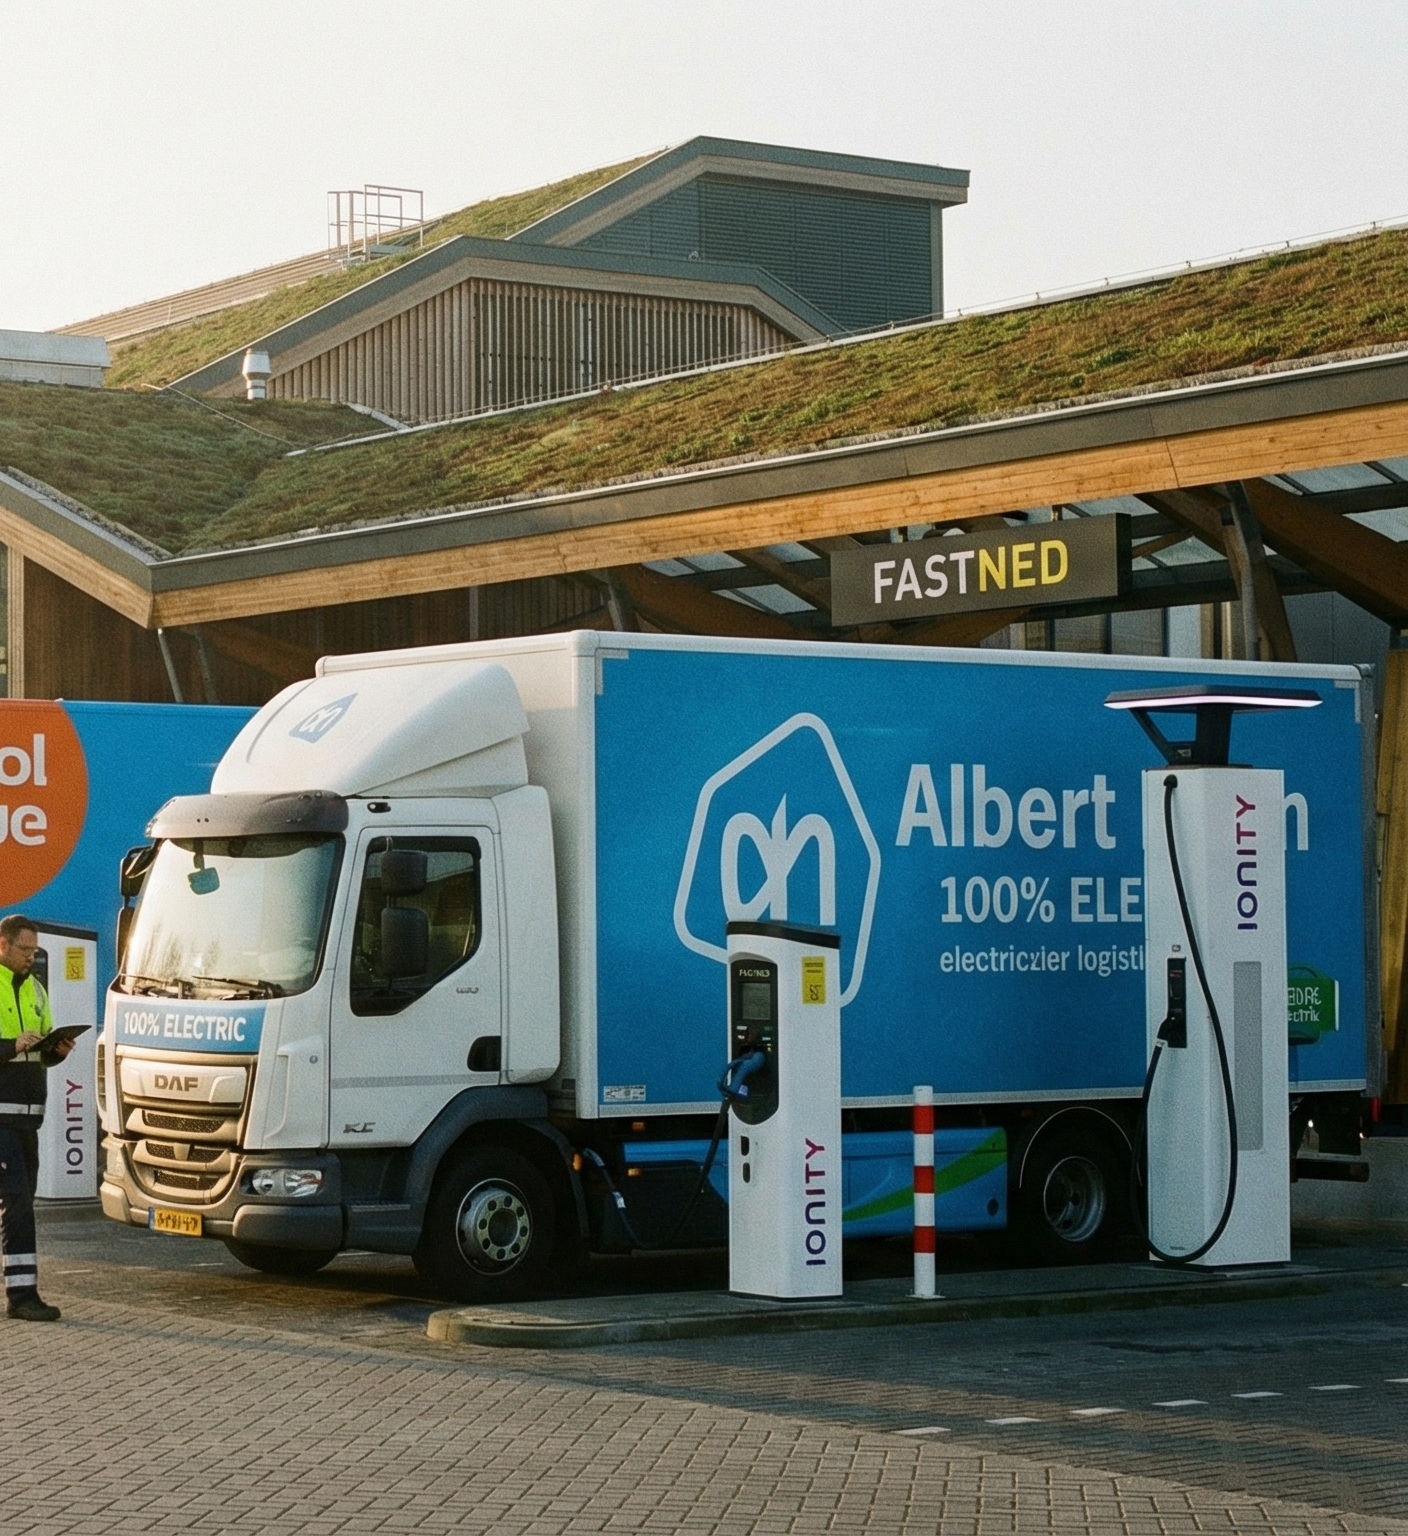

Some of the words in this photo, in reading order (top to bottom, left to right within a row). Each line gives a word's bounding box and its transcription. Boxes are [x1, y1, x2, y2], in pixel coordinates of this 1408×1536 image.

[874, 540, 1068, 604] FASTNED
[895, 763, 1117, 849] Albert
[940, 875, 1055, 923] 100%
[1235, 794, 1259, 930] IONITY
[124, 1011, 160, 1037] 100%
[163, 1013, 247, 1042] ELECTRIC
[154, 1074, 199, 1092] DAF
[66, 1079, 83, 1175] IONITY
[805, 1137, 826, 1266] IONITY
